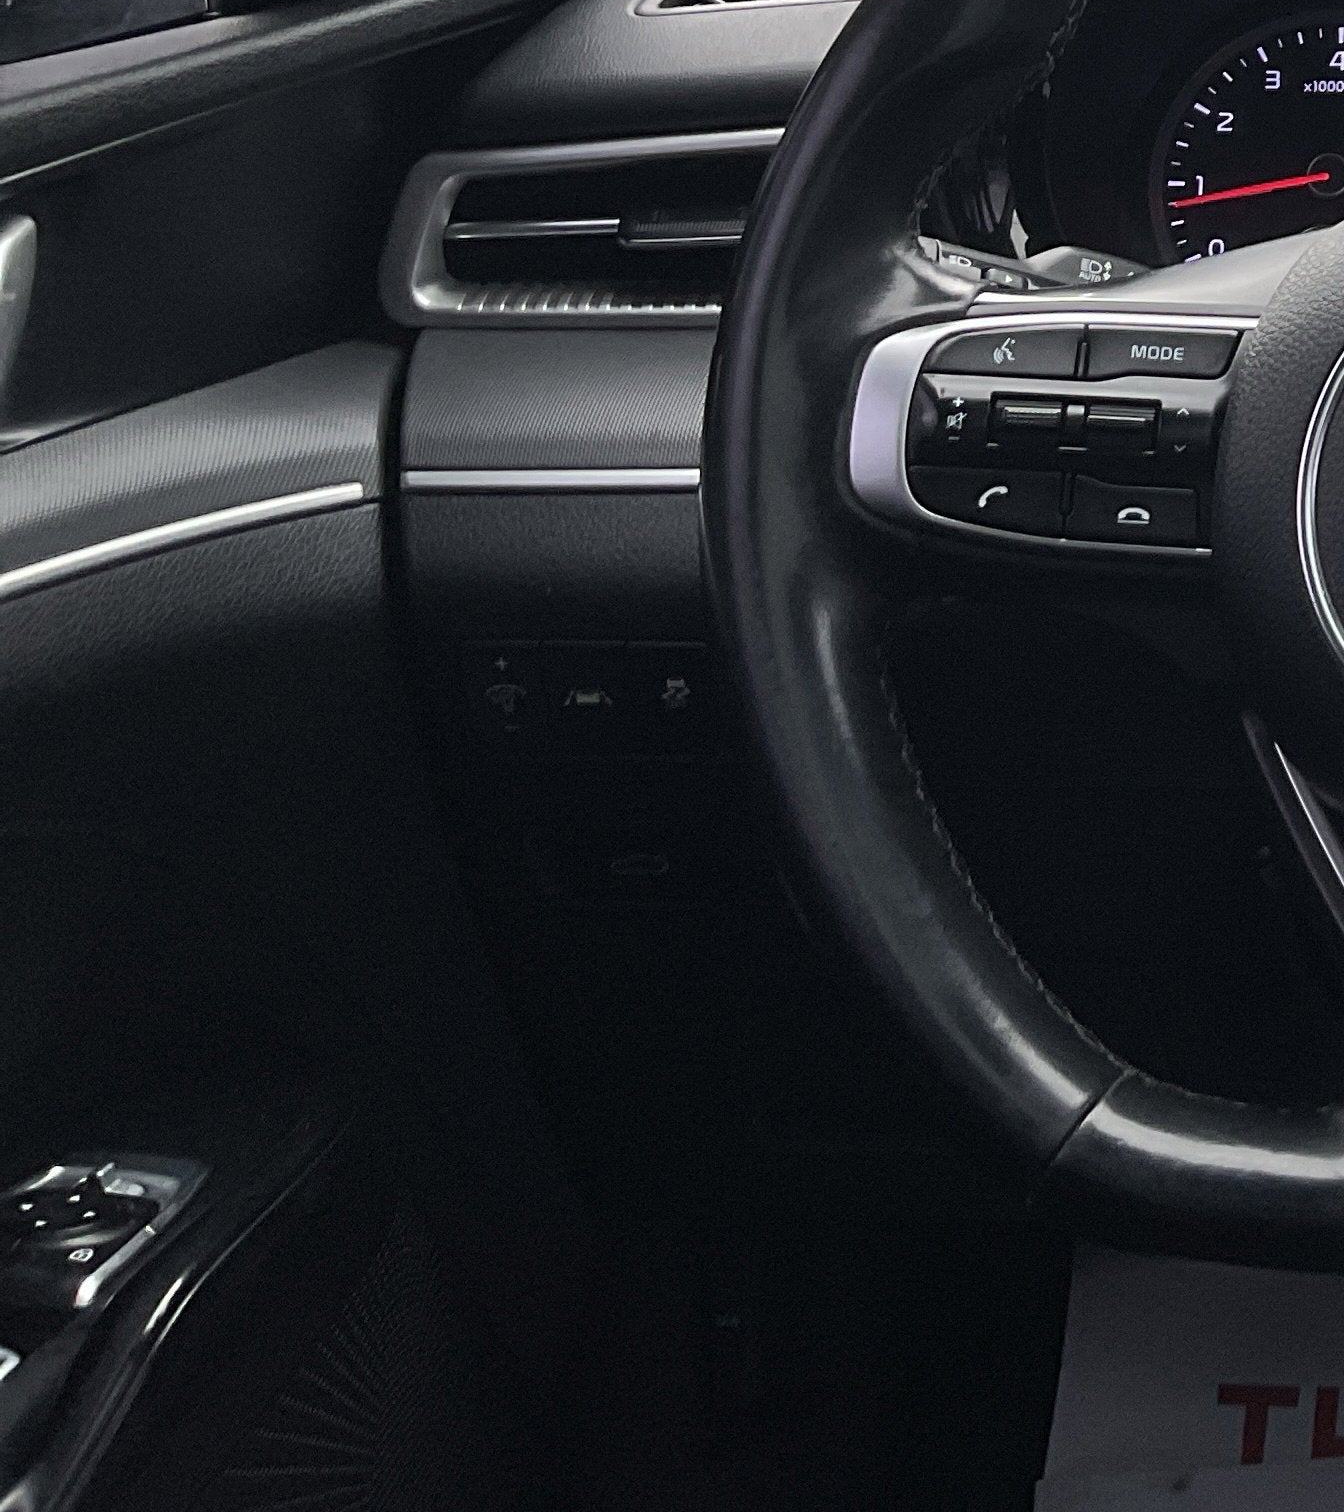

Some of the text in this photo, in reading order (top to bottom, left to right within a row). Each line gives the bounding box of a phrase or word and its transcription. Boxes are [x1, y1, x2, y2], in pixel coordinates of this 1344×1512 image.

[1265, 70, 1280, 89] 3
[1217, 112, 1233, 131] 2
[1131, 345, 1184, 361] MODE
